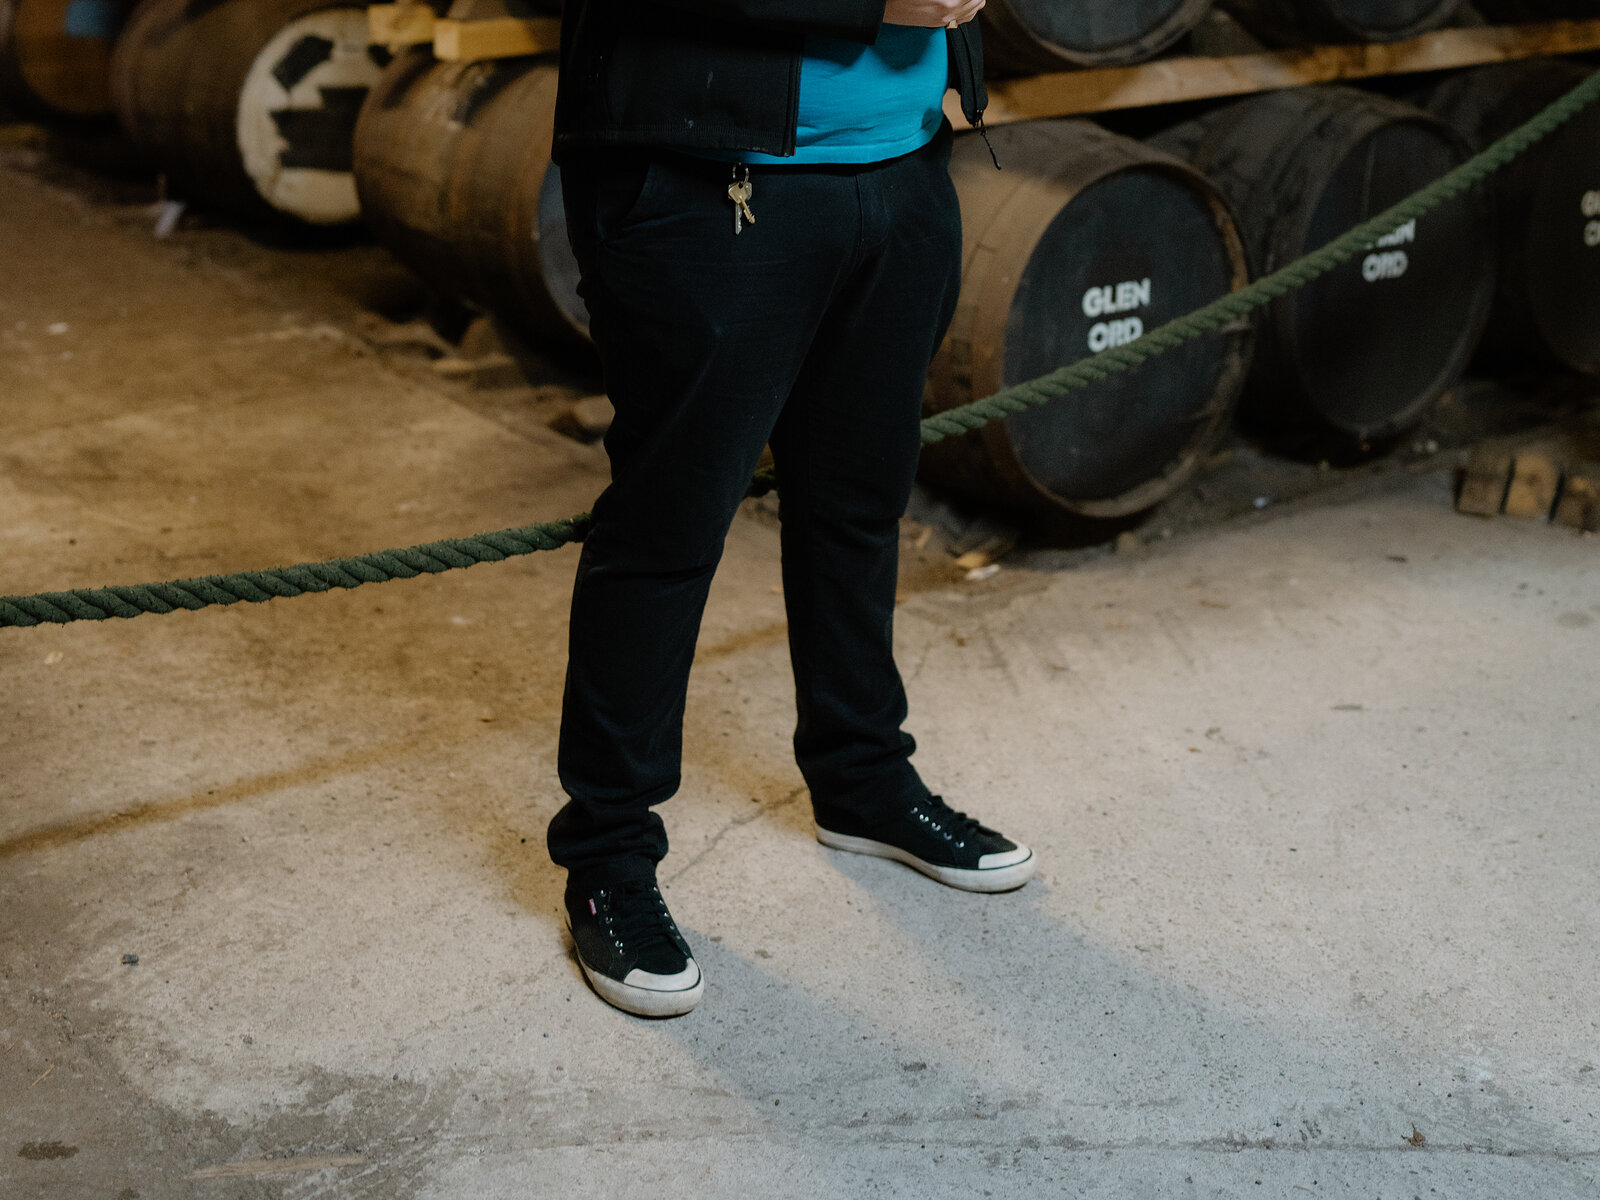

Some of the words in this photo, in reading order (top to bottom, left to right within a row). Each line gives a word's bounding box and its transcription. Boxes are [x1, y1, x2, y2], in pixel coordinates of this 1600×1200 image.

[1362, 250, 1408, 283] ORD
[1082, 277, 1151, 318] GLEN
[1088, 316, 1143, 353] ORD
